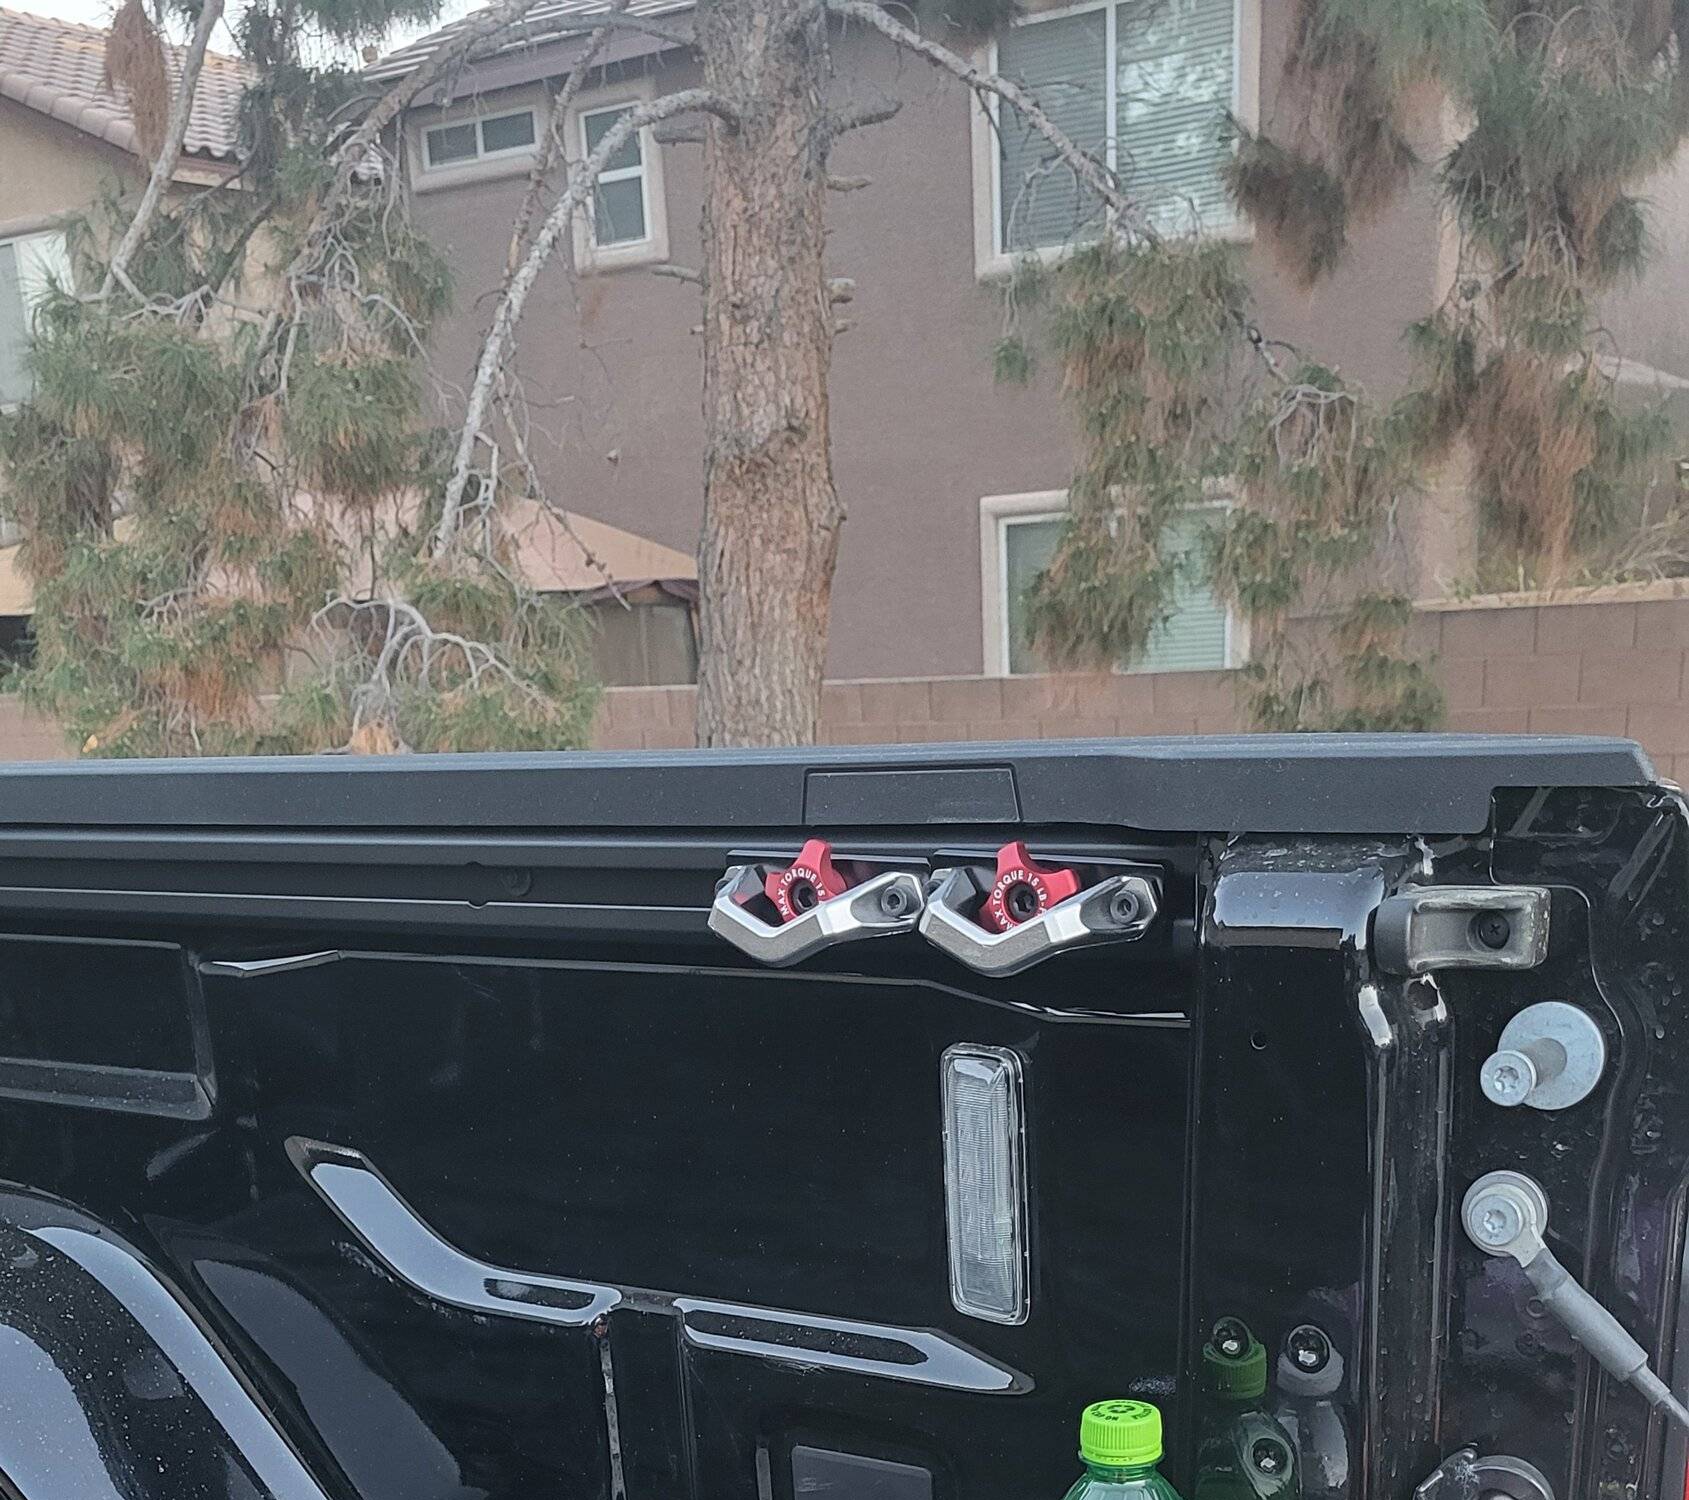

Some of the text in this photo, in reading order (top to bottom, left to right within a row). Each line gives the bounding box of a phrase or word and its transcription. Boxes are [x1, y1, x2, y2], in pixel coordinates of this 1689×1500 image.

[778, 867, 826, 916] MAX TORQUE 15
[993, 869, 1024, 906] TORQUE
[1027, 872, 1040, 887] 15
